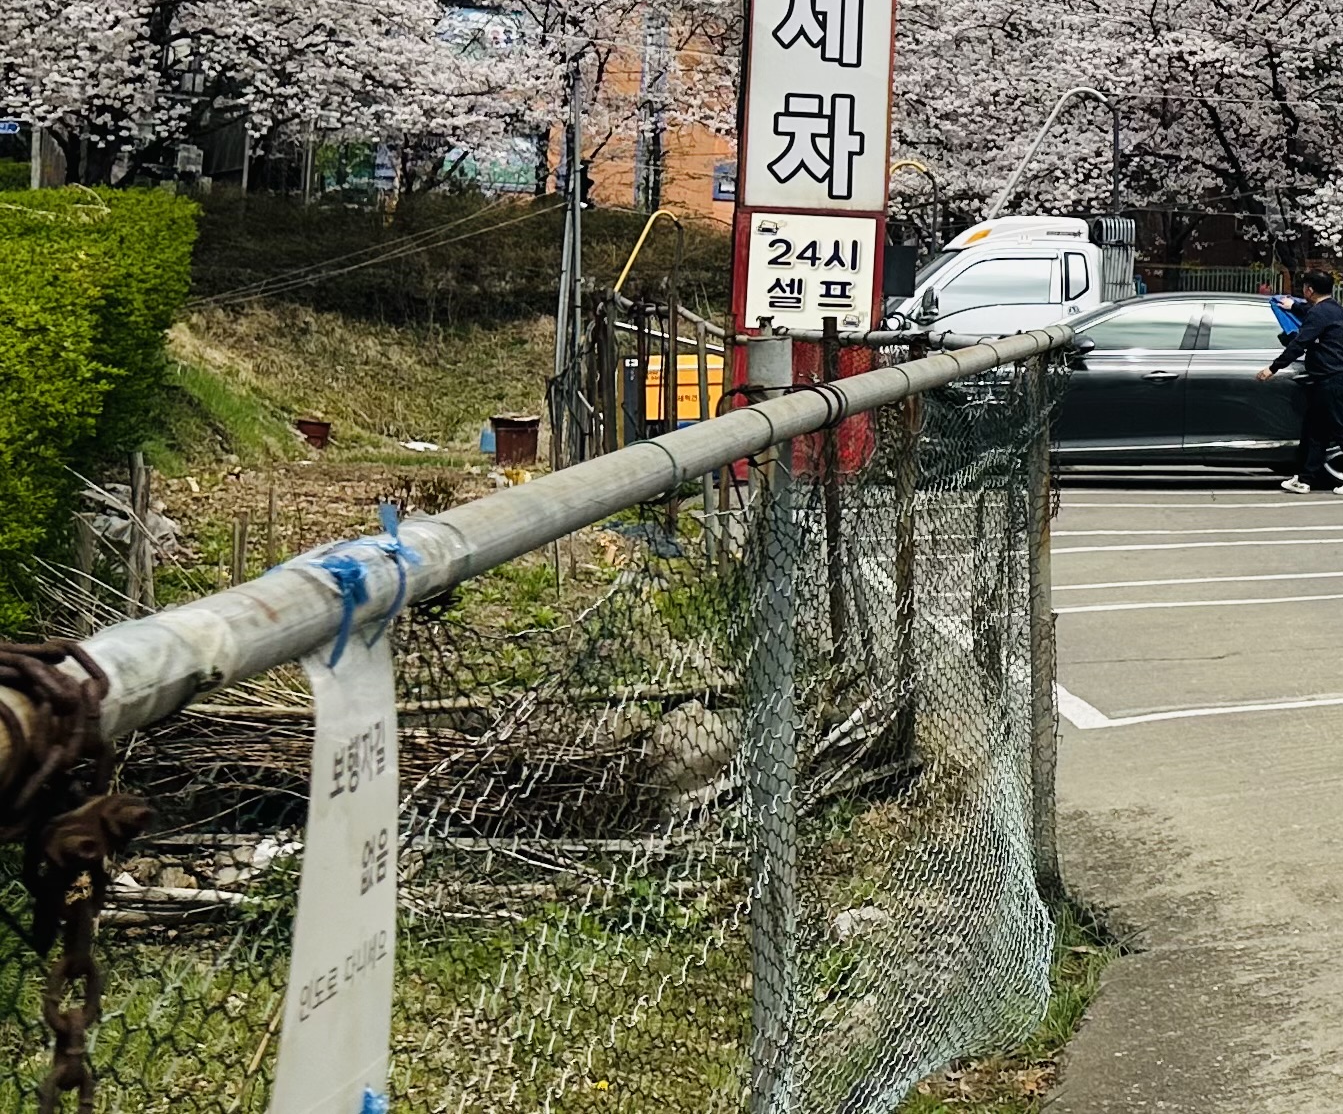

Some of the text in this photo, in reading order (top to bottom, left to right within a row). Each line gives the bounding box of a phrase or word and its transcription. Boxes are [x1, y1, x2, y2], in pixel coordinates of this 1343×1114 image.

[767, 238, 860, 271] 24시
[767, 277, 854, 310] 셀프
[330, 719, 386, 800] 보행자길
[360, 827, 389, 897] 없음
[300, 929, 388, 1023] 인도로 다니세요
